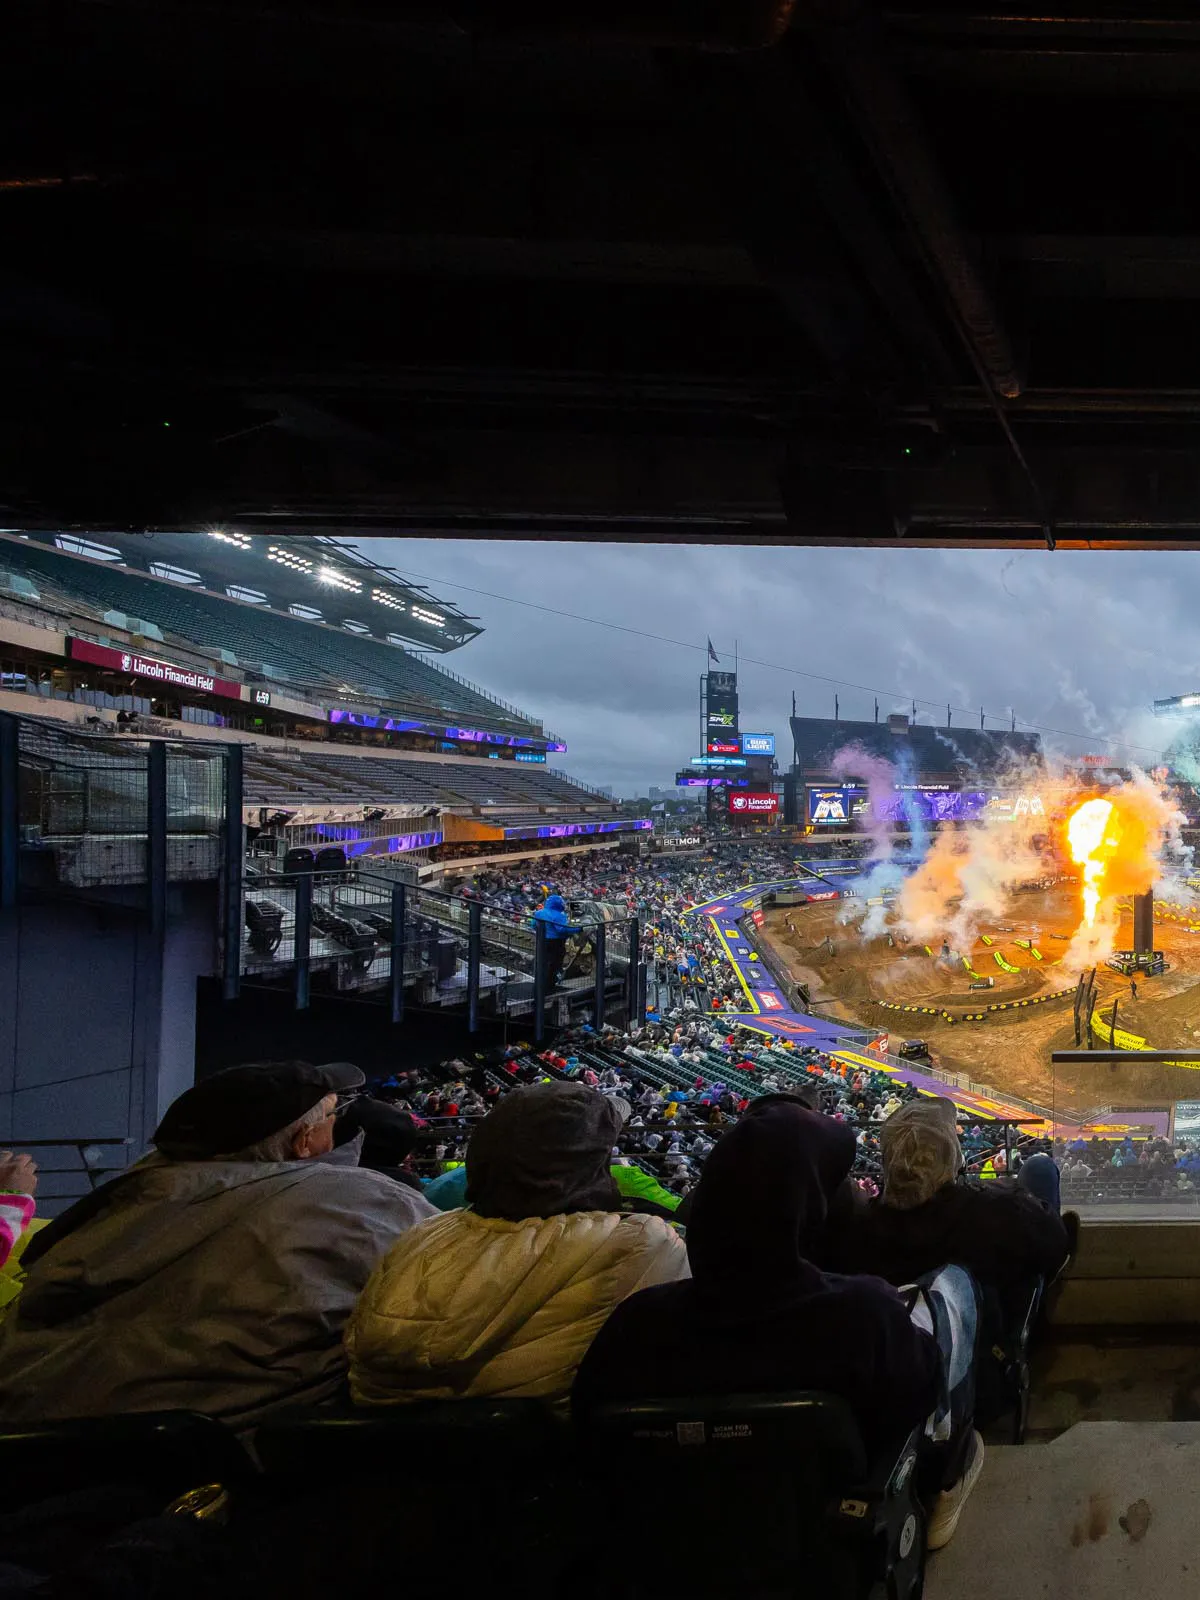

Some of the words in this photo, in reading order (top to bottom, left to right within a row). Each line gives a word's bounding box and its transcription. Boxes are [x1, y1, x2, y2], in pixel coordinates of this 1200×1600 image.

[133, 659, 164, 679] Lincoln
[164, 667, 197, 688] Financial
[197, 674, 214, 690] Field
[256, 690, 270, 704] 6:59
[663, 837, 700, 846] BETMGM
